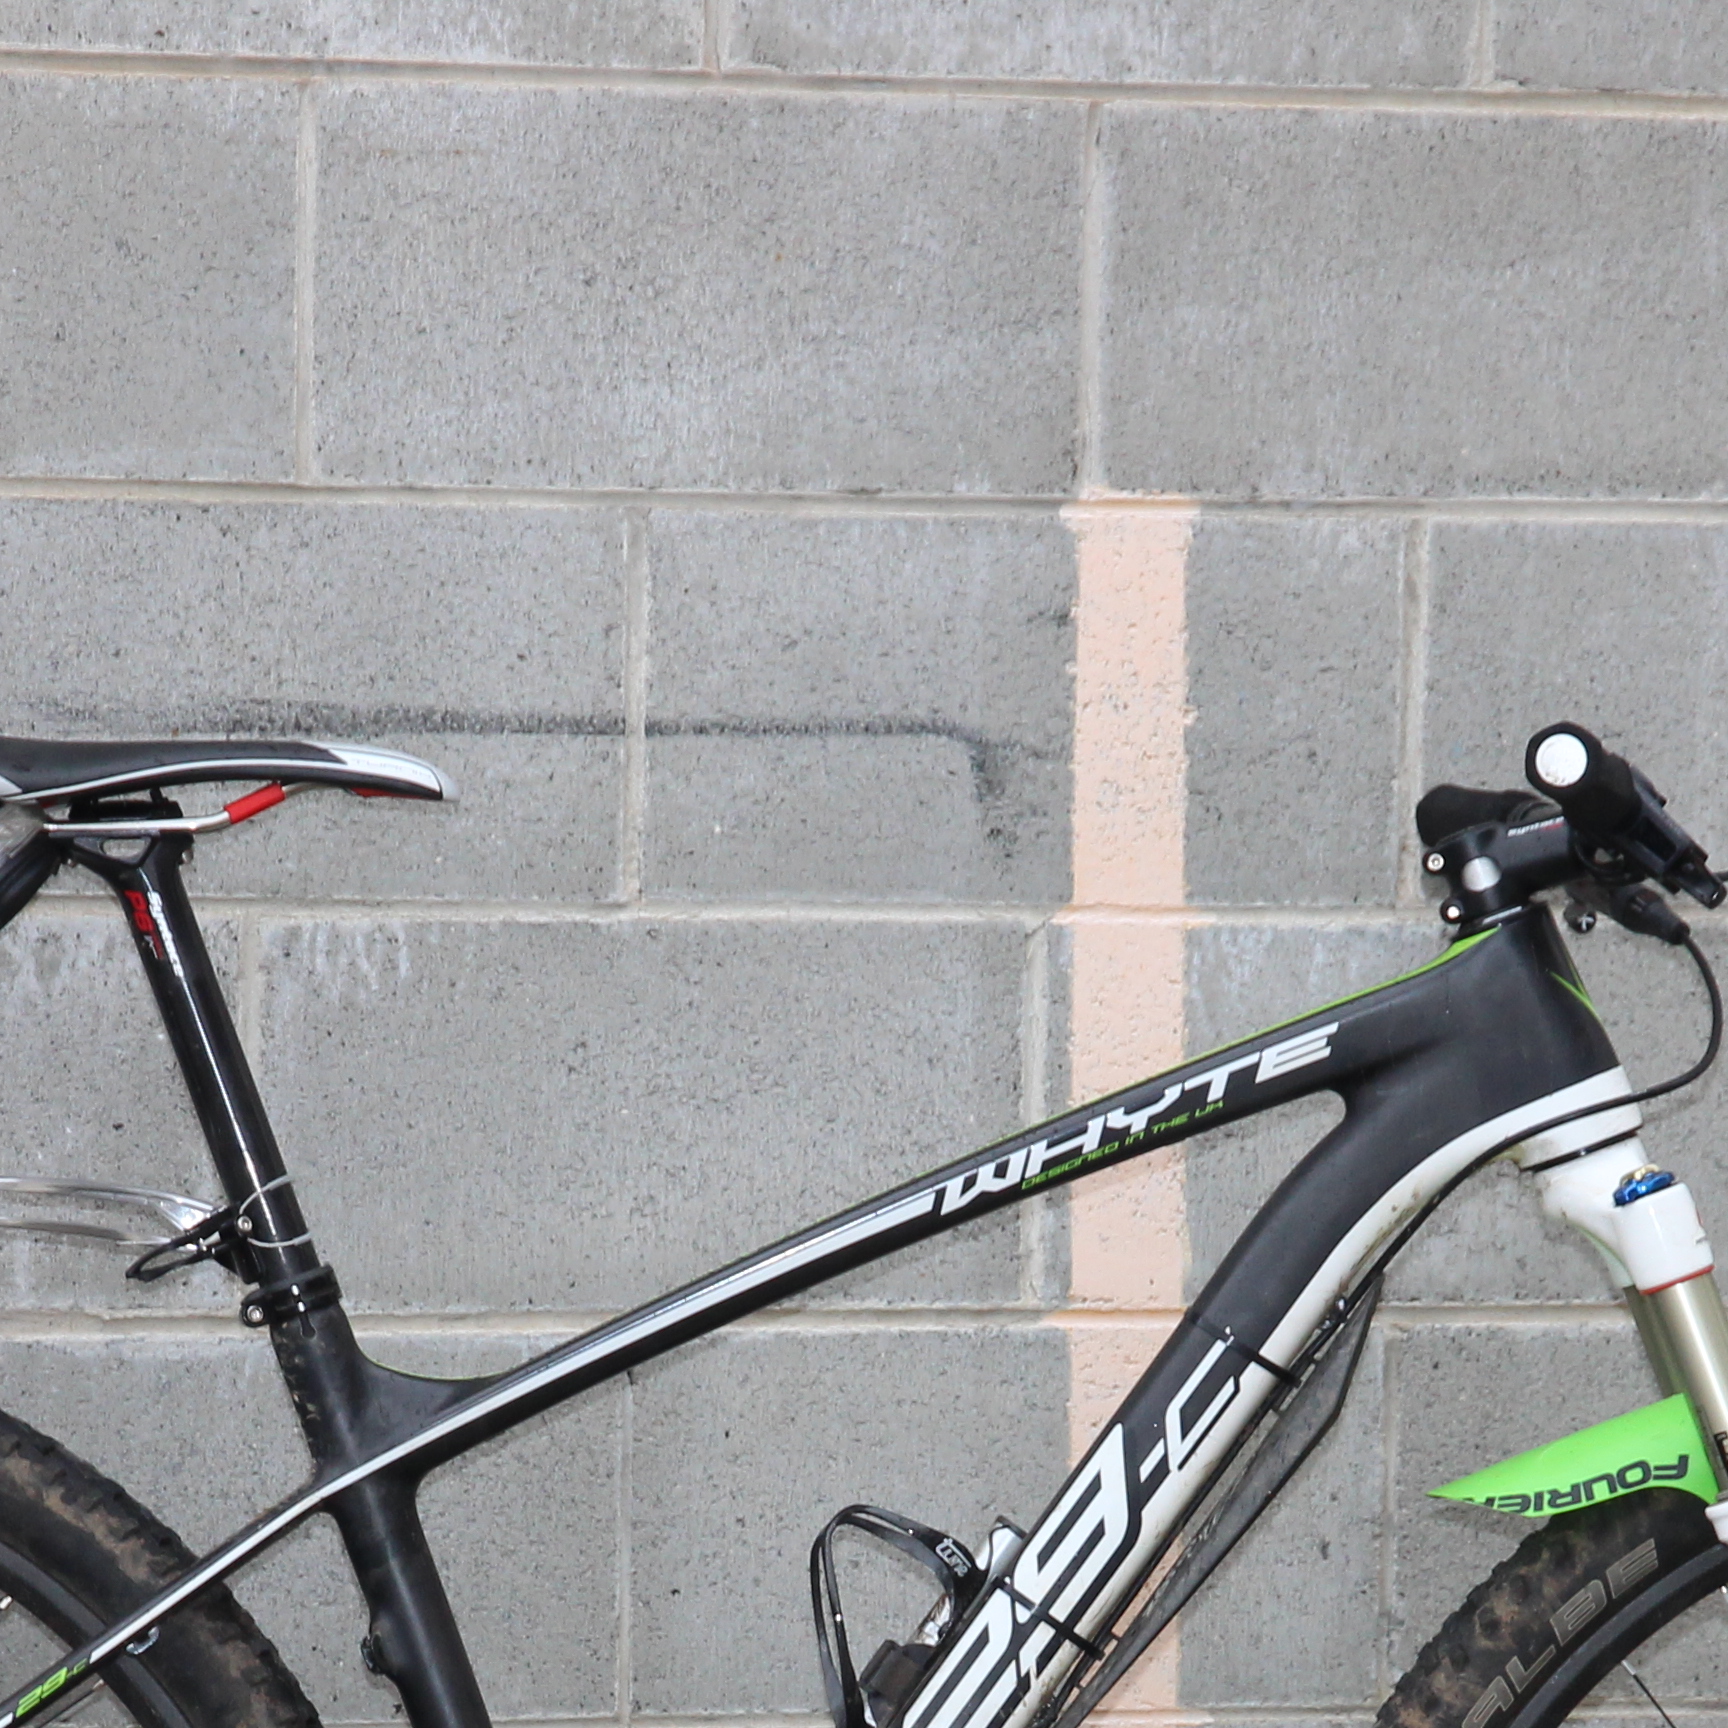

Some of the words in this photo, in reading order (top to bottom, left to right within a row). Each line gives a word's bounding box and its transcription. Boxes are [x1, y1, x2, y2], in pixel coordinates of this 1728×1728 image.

[940, 1022, 1340, 1216] WHYTE
[1022, 1141, 1119, 1189] DESIGNED
[1125, 1131, 1144, 1146] IN
[1152, 1112, 1190, 1134] THE
[1194, 1101, 1224, 1118] UK
